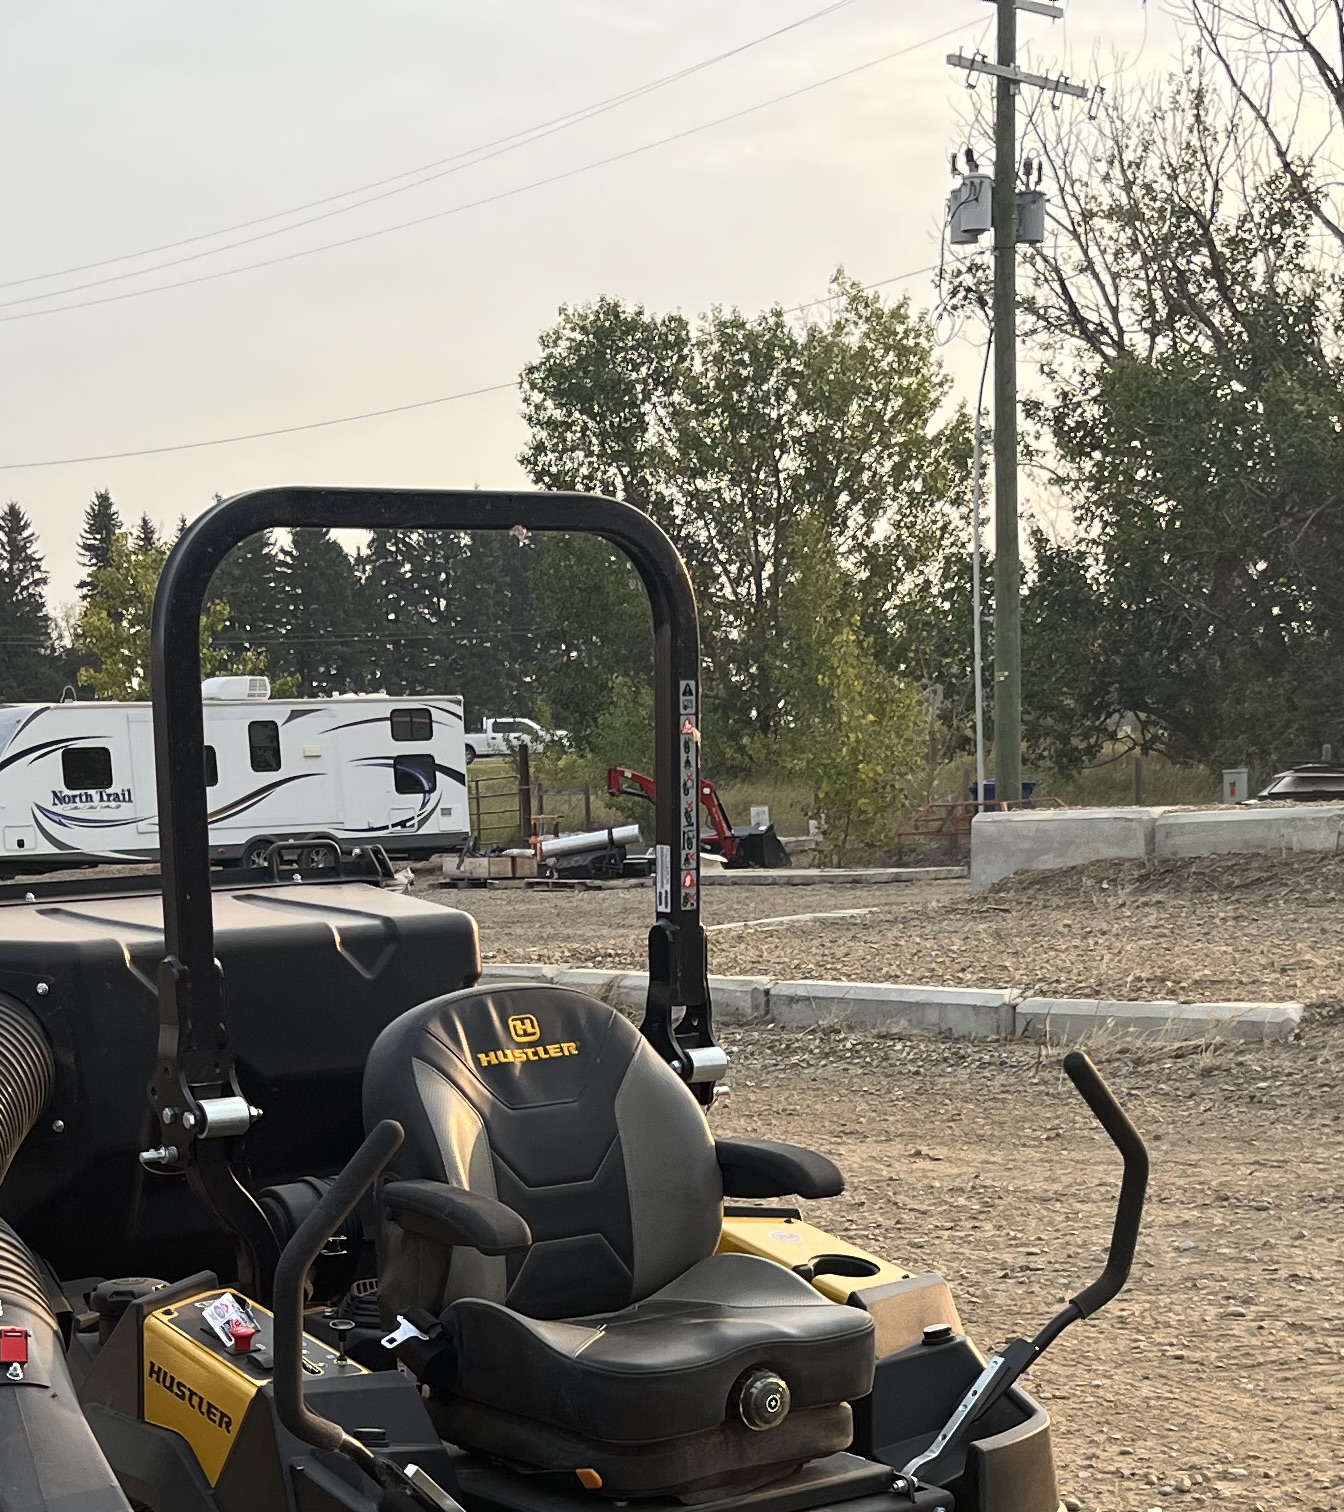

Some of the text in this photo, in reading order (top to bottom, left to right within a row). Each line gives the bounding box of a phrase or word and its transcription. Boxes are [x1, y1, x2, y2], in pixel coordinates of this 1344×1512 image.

[51, 789, 133, 806] North Trail
[510, 1016, 538, 1039] H
[477, 1042, 579, 1067] HUSTLER
[148, 1360, 233, 1434] HUSTLER
